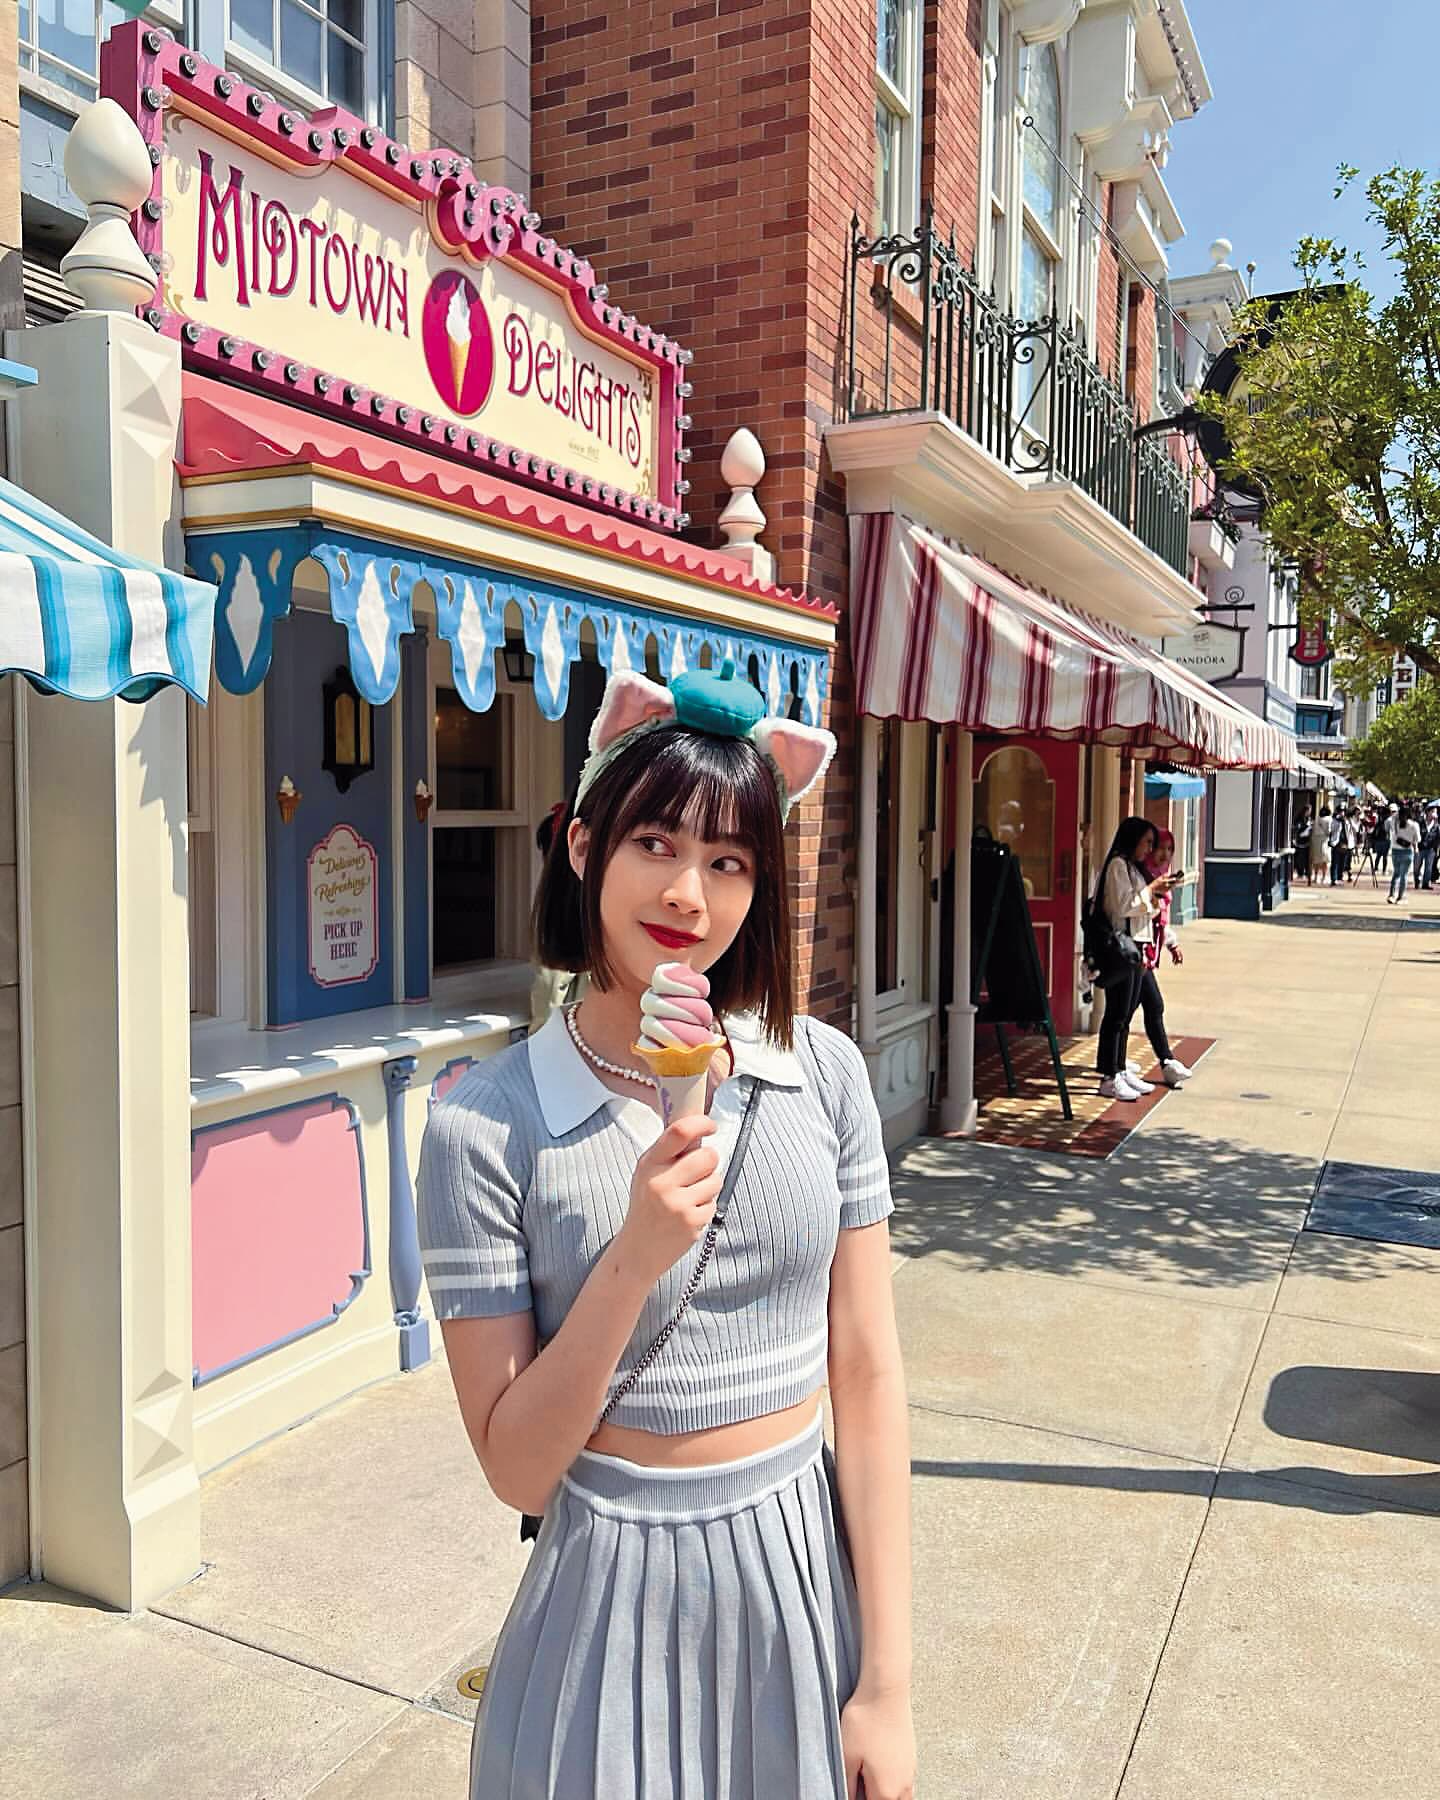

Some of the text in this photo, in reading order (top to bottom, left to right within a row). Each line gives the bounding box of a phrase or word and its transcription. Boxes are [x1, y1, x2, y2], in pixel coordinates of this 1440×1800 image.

[194, 149, 410, 338] MIDTOWN
[1176, 655, 1225, 665] PANDORA
[318, 853, 366, 875] Delicious
[324, 920, 363, 941] PICK UP
[330, 942, 358, 960] HERE
